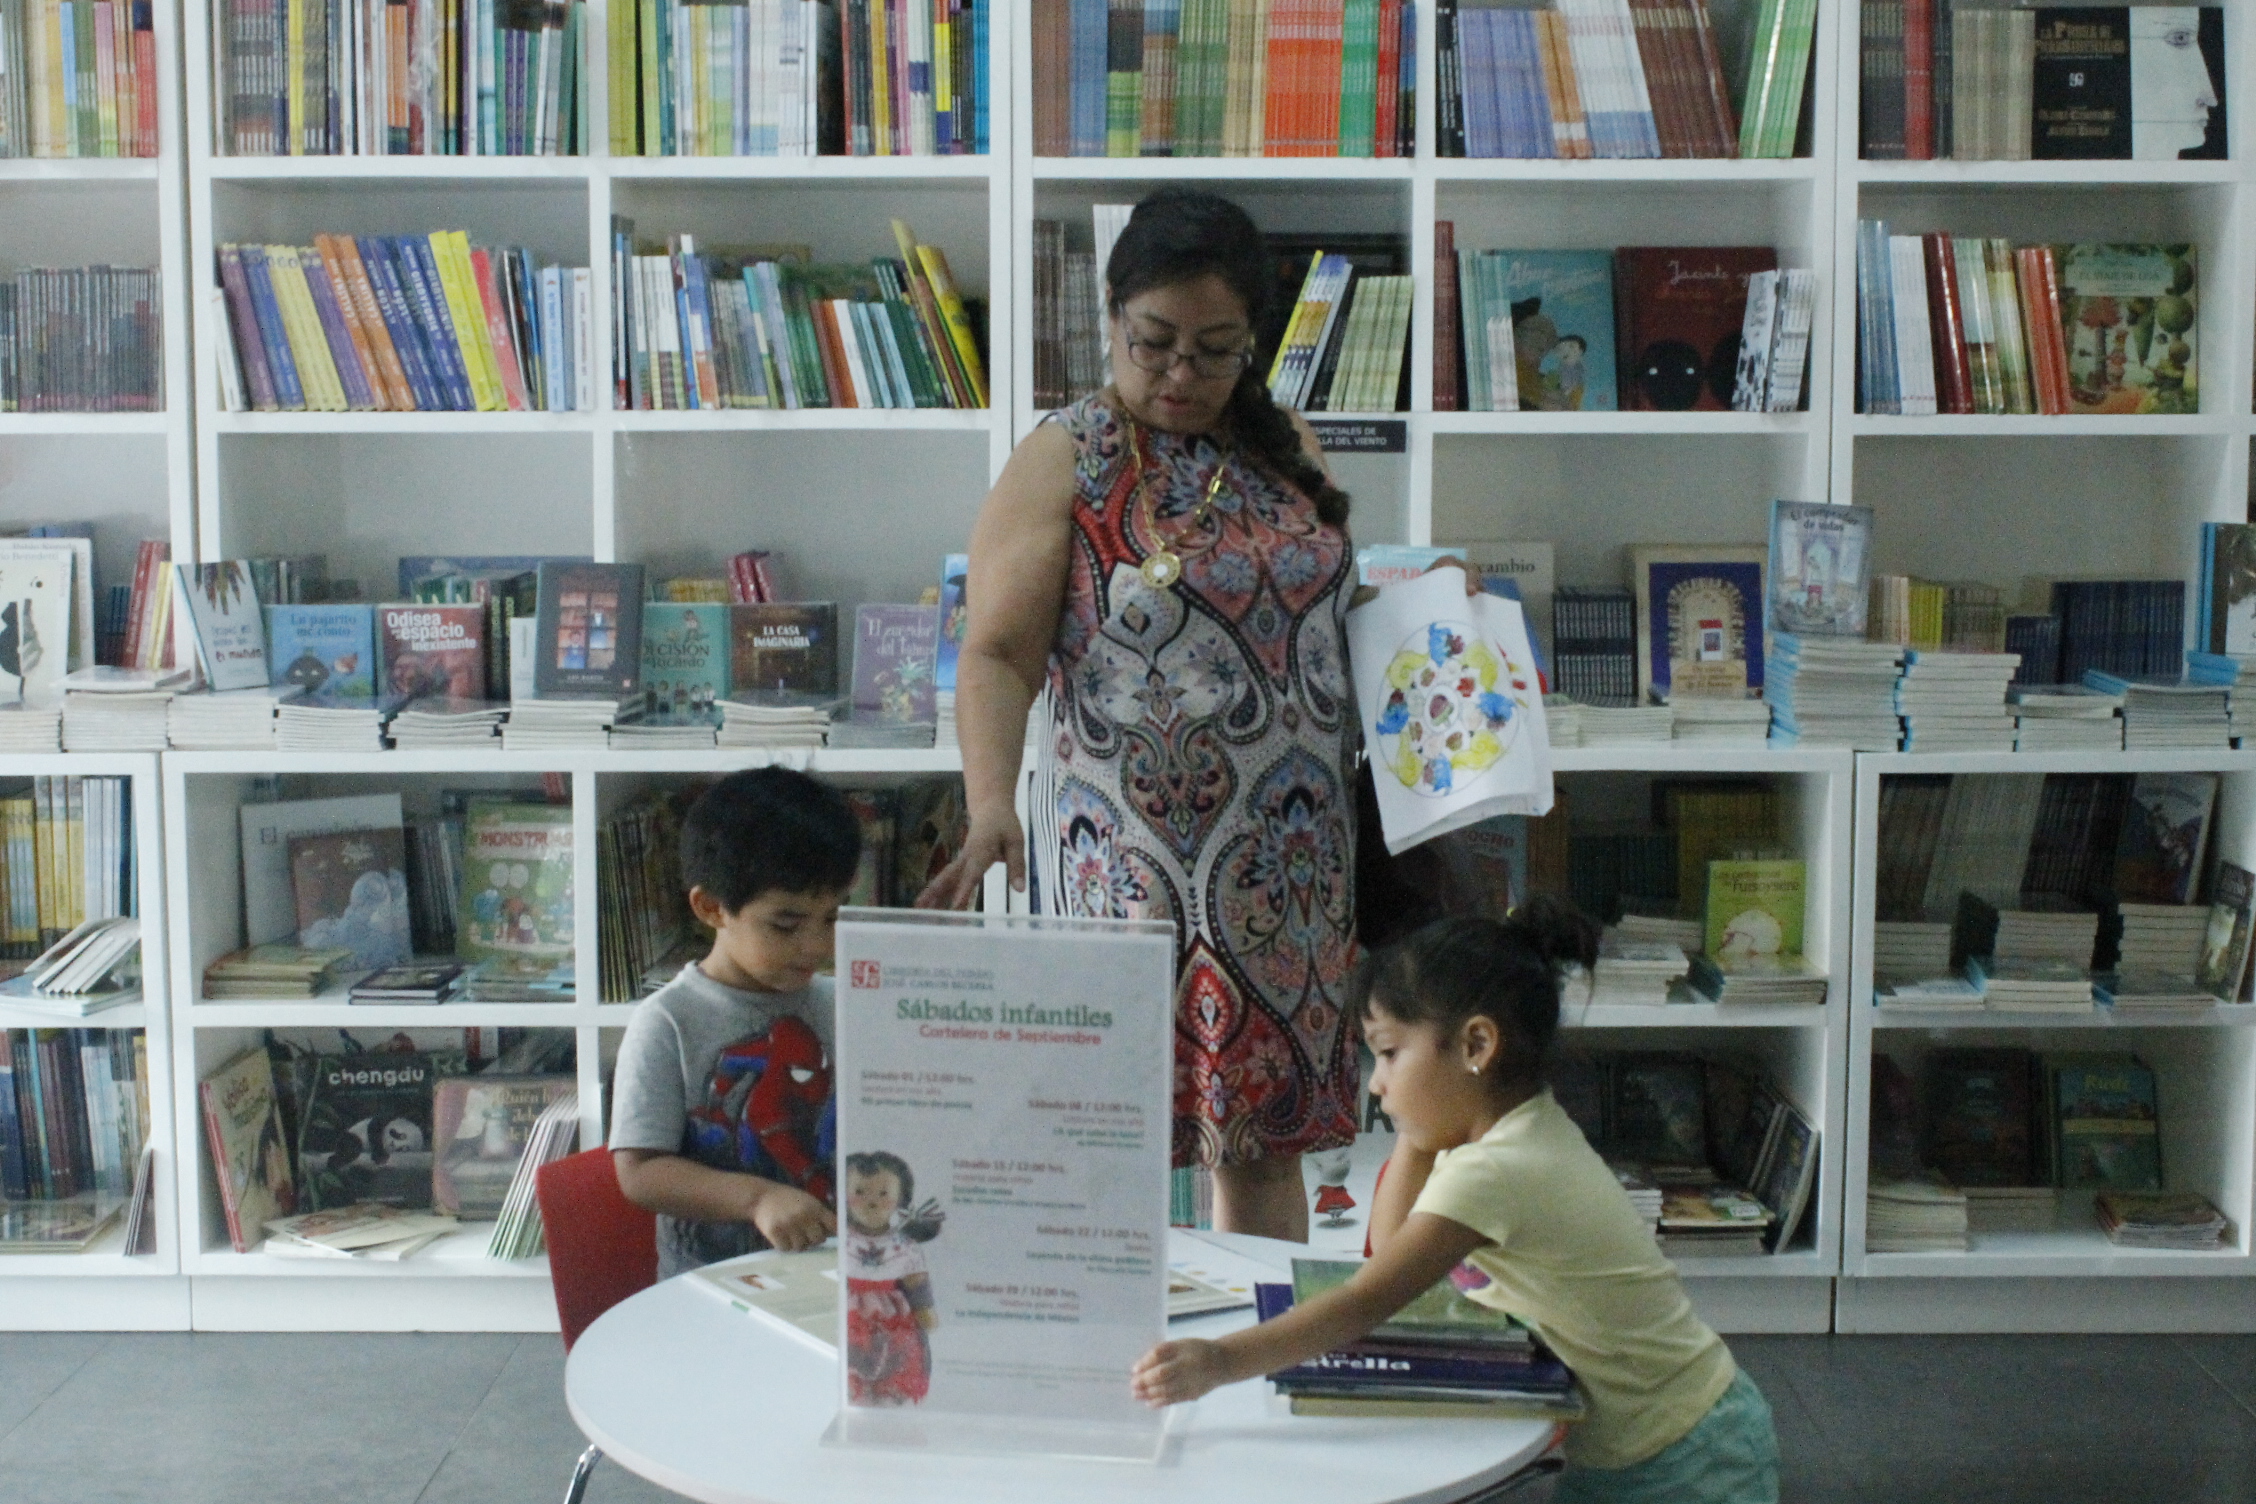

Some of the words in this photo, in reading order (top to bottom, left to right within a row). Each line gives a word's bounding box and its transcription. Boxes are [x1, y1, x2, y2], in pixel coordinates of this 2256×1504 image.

[1315, 427, 1362, 436] SPECIALES
[387, 611, 442, 629] Odisea
[401, 622, 465, 642] espacio
[763, 625, 776, 636] LA
[777, 625, 801, 636] CASA
[411, 638, 478, 652] inexistente
[753, 636, 811, 648] IMAGINARIA
[896, 999, 993, 1024] Sábados
[1000, 1004, 1114, 1028] infantiles
[993, 1026, 1013, 1042] de
[1017, 1027, 1102, 1046] Septiembre
[327, 1065, 425, 1088] chengdu
